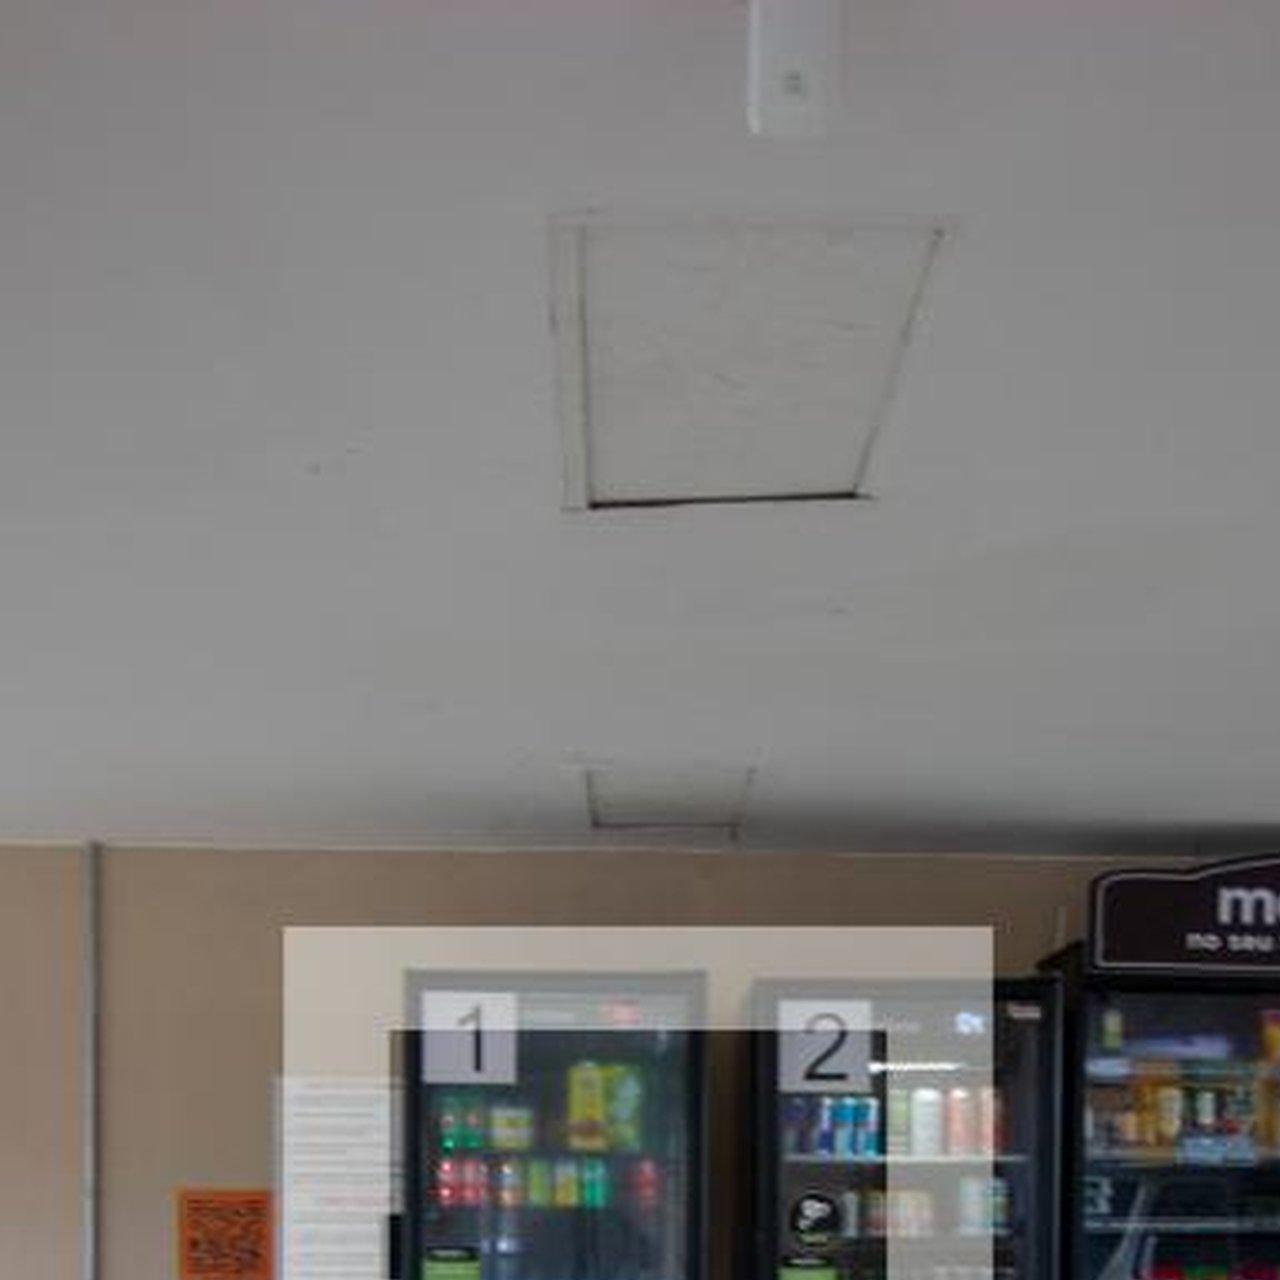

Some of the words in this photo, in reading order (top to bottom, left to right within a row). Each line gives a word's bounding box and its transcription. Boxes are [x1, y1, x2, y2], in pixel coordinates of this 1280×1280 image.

[1185, 932, 1222, 950] no
[1227, 933, 1274, 951] seu
[457, 1005, 482, 1072] 1
[803, 1012, 850, 1082] 2
